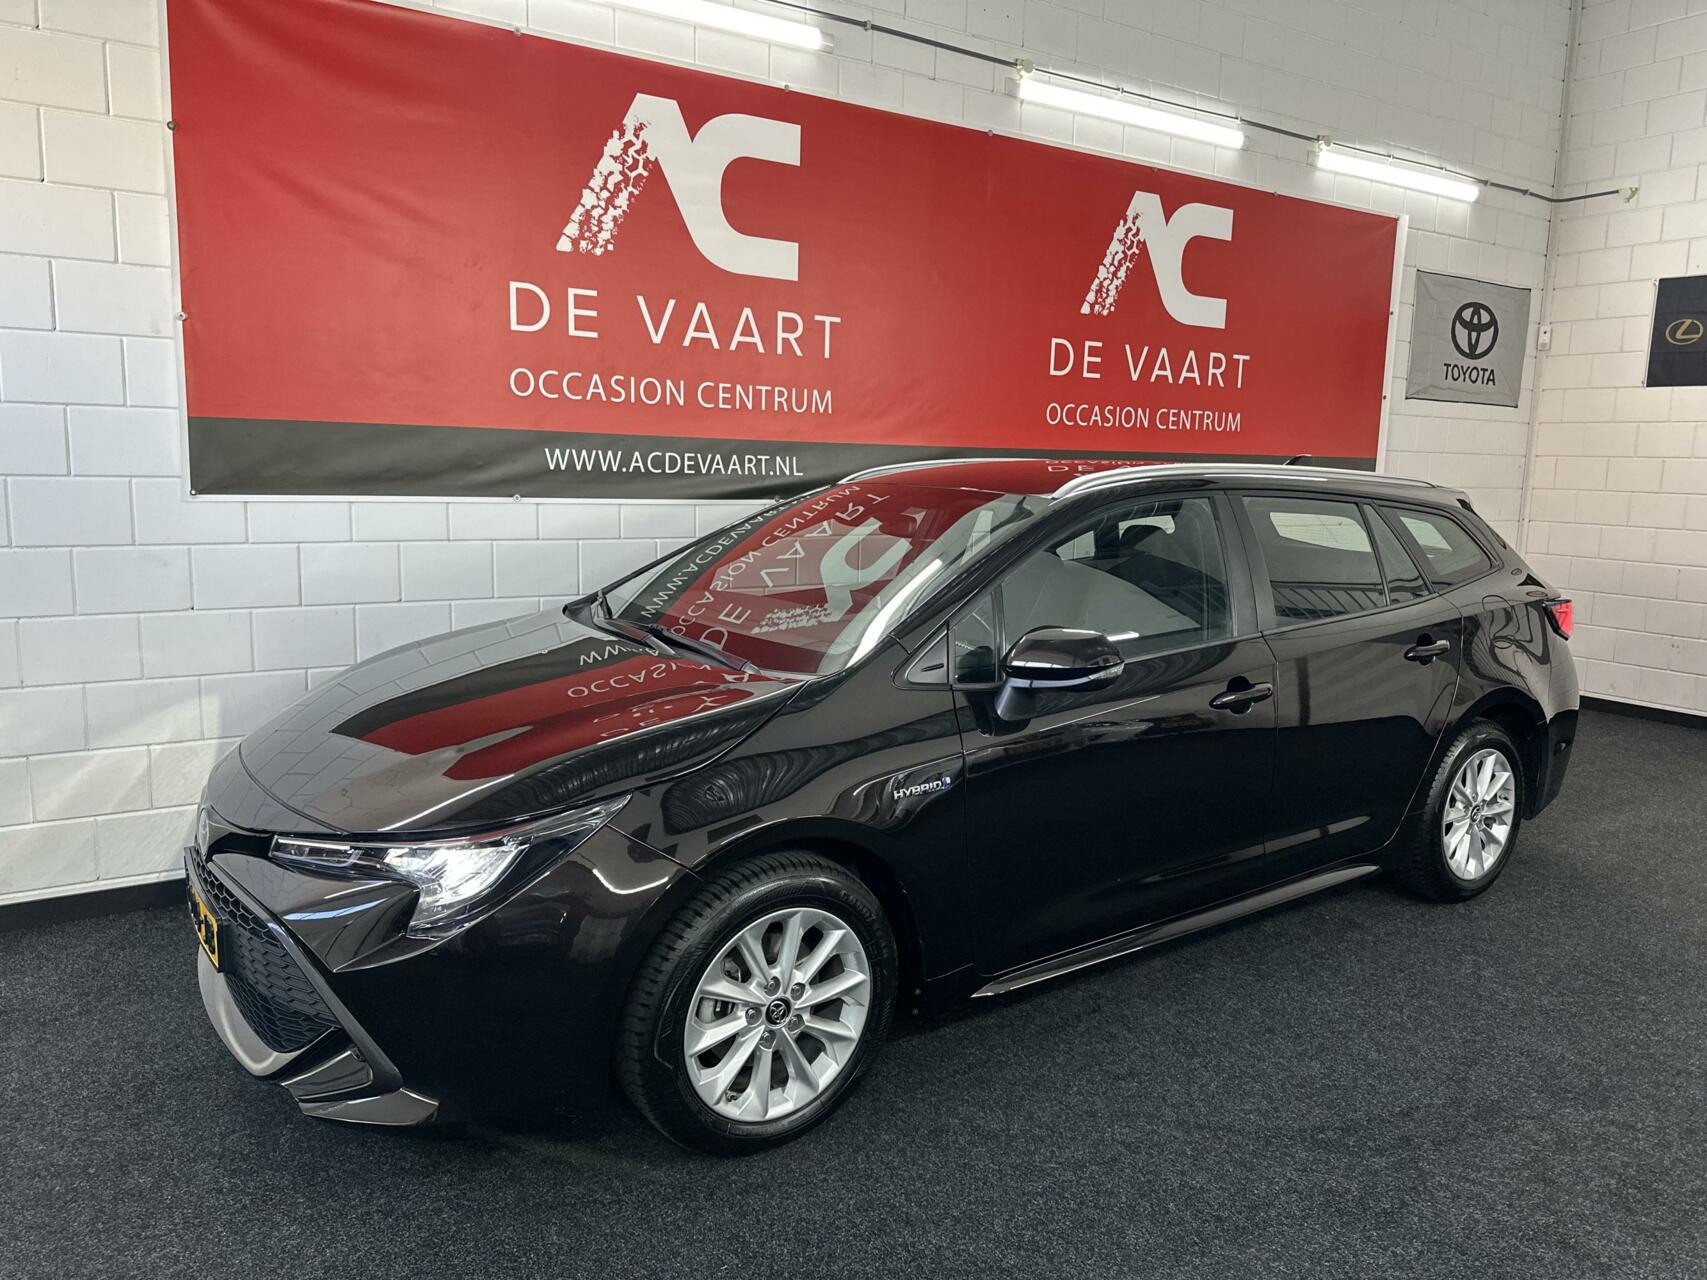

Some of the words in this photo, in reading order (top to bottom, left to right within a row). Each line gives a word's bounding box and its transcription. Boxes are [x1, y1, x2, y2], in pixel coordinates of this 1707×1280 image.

[555, 92, 801, 281] AC
[1080, 190, 1234, 329] AC
[509, 280, 599, 338] DE
[636, 295, 841, 359] VAART
[1049, 337, 1103, 379] DE
[1125, 344, 1250, 389] VAART
[1443, 363, 1496, 386] TOYOTA
[510, 367, 685, 406] OCCASION
[697, 381, 833, 414] CENTRUM
[1046, 402, 1149, 429] OCCASION
[1156, 408, 1241, 432] CENTRUM
[545, 447, 804, 476] WWW.ACDEVAART.NL
[893, 780, 943, 800] HYBRID
